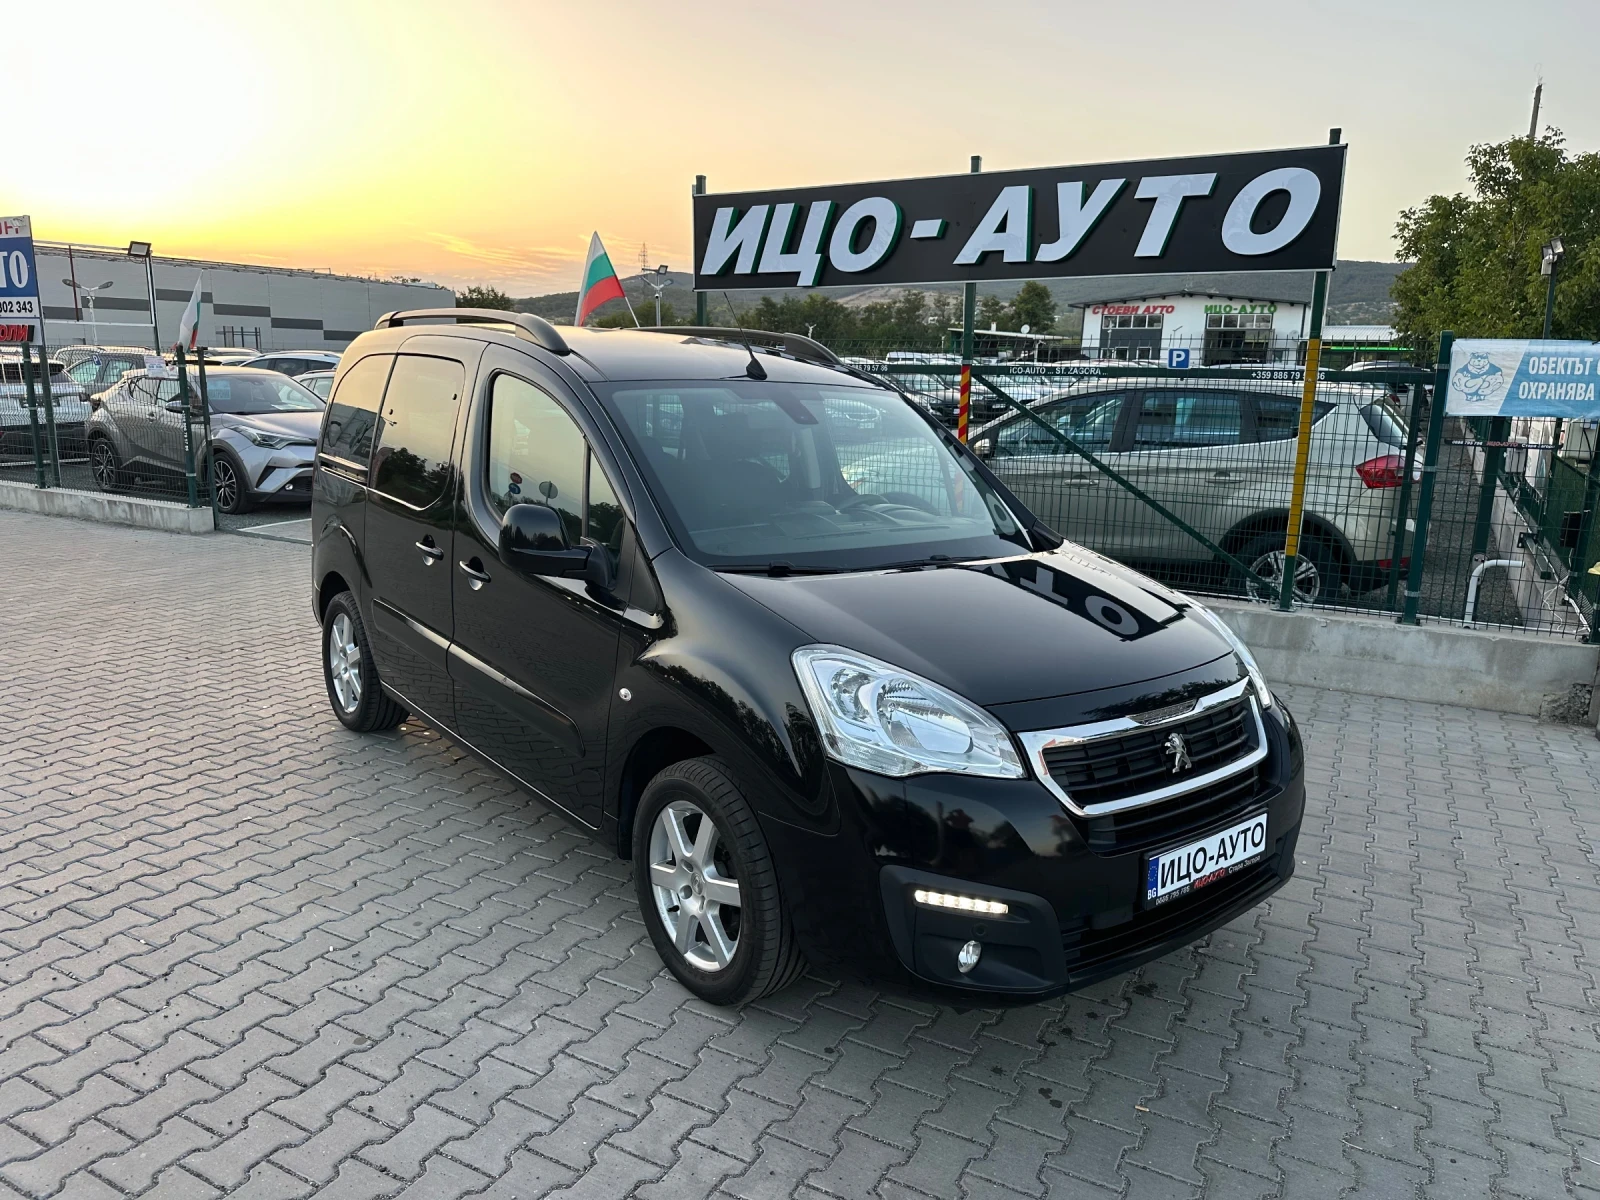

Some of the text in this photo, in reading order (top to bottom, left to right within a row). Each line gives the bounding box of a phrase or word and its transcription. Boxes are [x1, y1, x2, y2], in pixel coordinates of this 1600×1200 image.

[699, 166, 1322, 287] ИЦО-АУТО
[16, 300, 33, 313] 343
[1092, 305, 1175, 315] СТОЕВИ АУТО
[1204, 304, 1278, 314] ИЦО-АУТО
[1172, 351, 1185, 367] P
[1529, 356, 1593, 375] ОБЕКТЪТ
[1251, 371, 1271, 379] +359
[1518, 381, 1595, 401] ОХРАНЯВА
[1160, 822, 1265, 890] ИЦО-АУТО
[1147, 888, 1157, 900] BG
